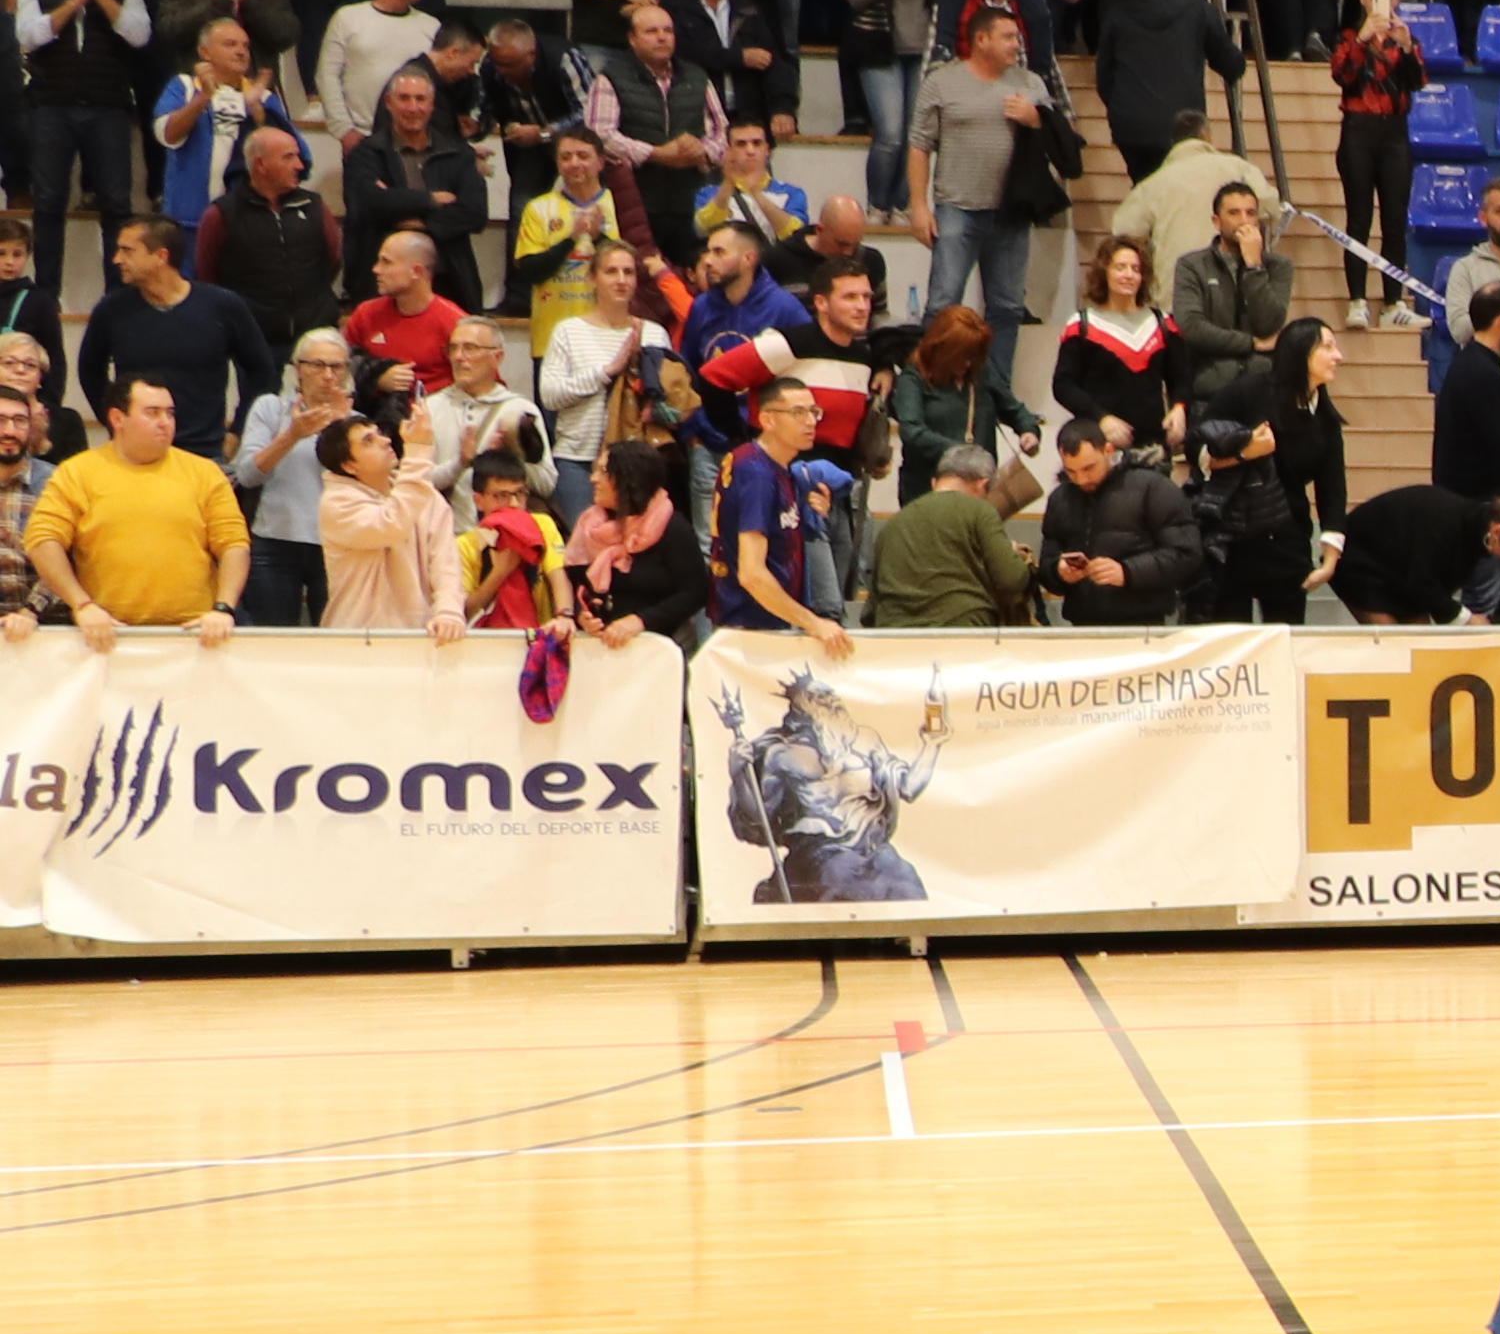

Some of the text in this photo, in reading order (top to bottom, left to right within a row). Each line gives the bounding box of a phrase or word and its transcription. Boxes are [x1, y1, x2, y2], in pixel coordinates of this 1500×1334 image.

[975, 662, 1271, 713] AGUA DE BENASSAL
[1080, 704, 1148, 725] manantial
[1149, 703, 1195, 720] Fuente
[1197, 703, 1215, 717] en
[1217, 697, 1271, 719] Segures
[193, 741, 660, 815] Kromex
[400, 820, 662, 837] EL FUTURO DEL DEPORTE BASE
